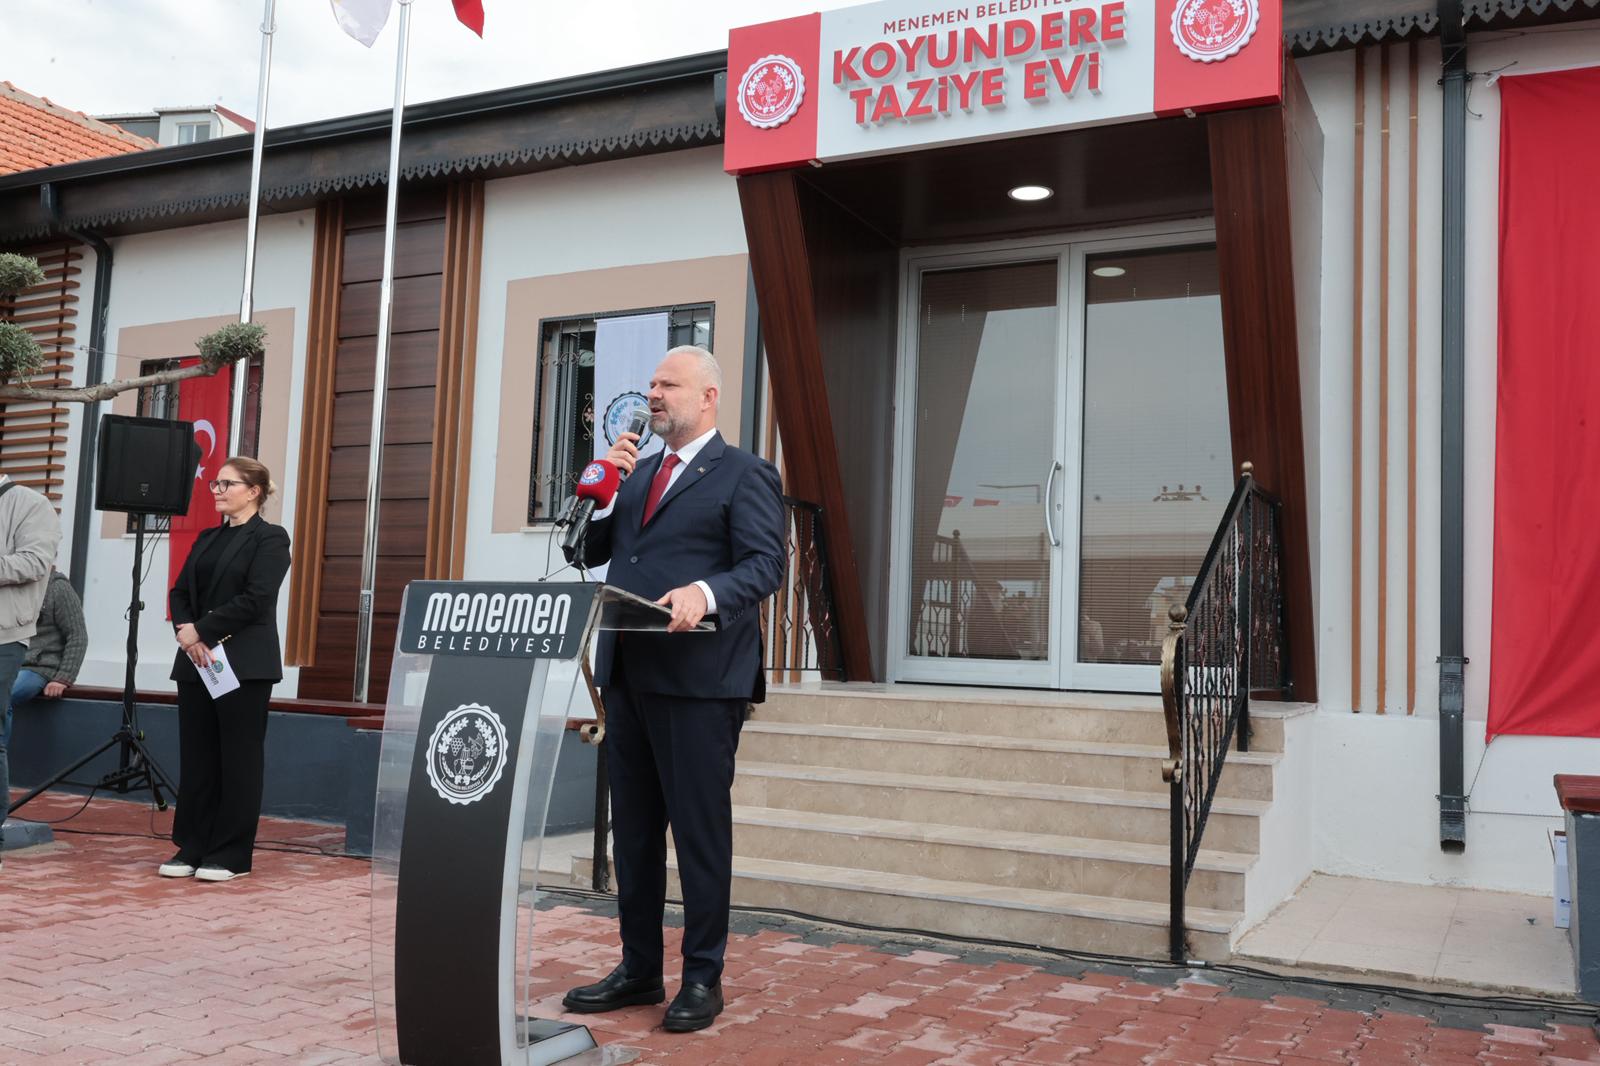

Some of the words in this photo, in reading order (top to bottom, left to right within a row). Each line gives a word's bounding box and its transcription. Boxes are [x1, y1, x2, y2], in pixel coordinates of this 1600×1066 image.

[833, 1, 1125, 84] KOYUNDERE
[883, 8, 969, 34] MENEMEN
[850, 67, 1004, 124] TAZİYE
[1024, 52, 1100, 100] EVİ
[417, 634, 565, 654] BELEDİYESİ
